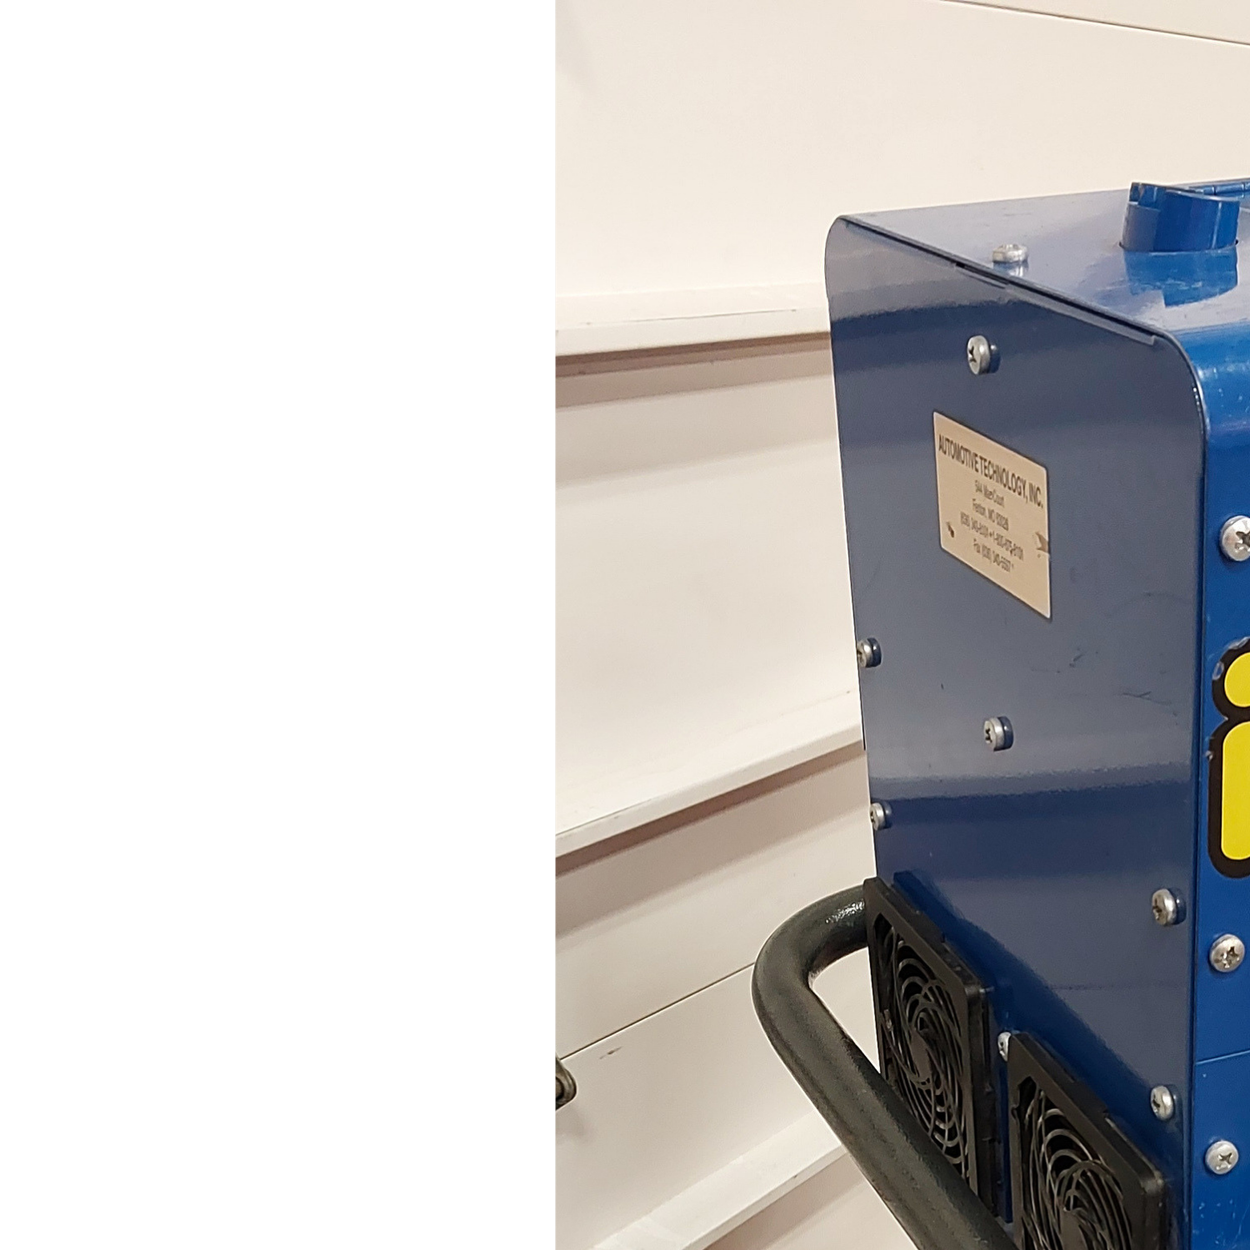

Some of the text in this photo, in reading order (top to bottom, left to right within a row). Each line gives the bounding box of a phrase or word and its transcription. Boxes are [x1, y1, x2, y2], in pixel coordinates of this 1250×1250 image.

[938, 433, 1044, 509] AUTOMOTIVE TECHNOLOGY, INC.
